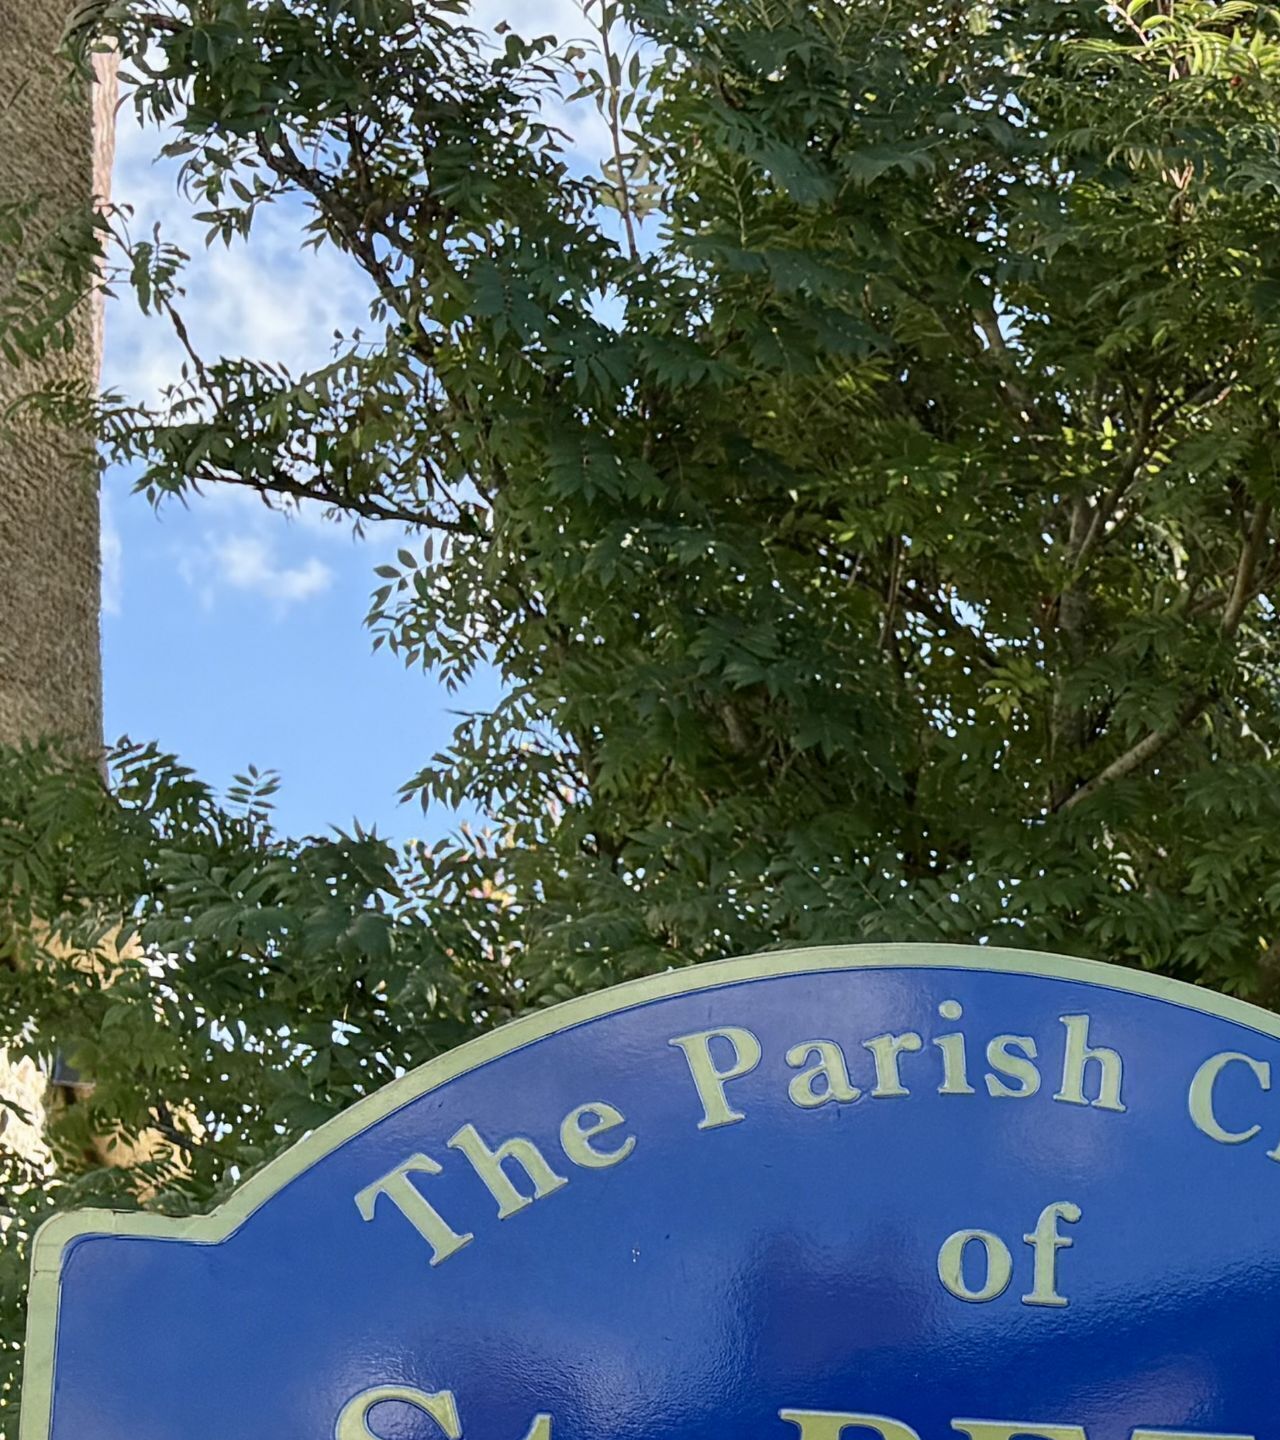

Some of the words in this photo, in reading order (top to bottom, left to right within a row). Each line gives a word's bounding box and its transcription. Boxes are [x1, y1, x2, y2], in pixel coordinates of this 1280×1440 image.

[355, 1100, 637, 1268] The
[669, 999, 1128, 1130] Parish
[938, 1202, 1082, 1306] of
